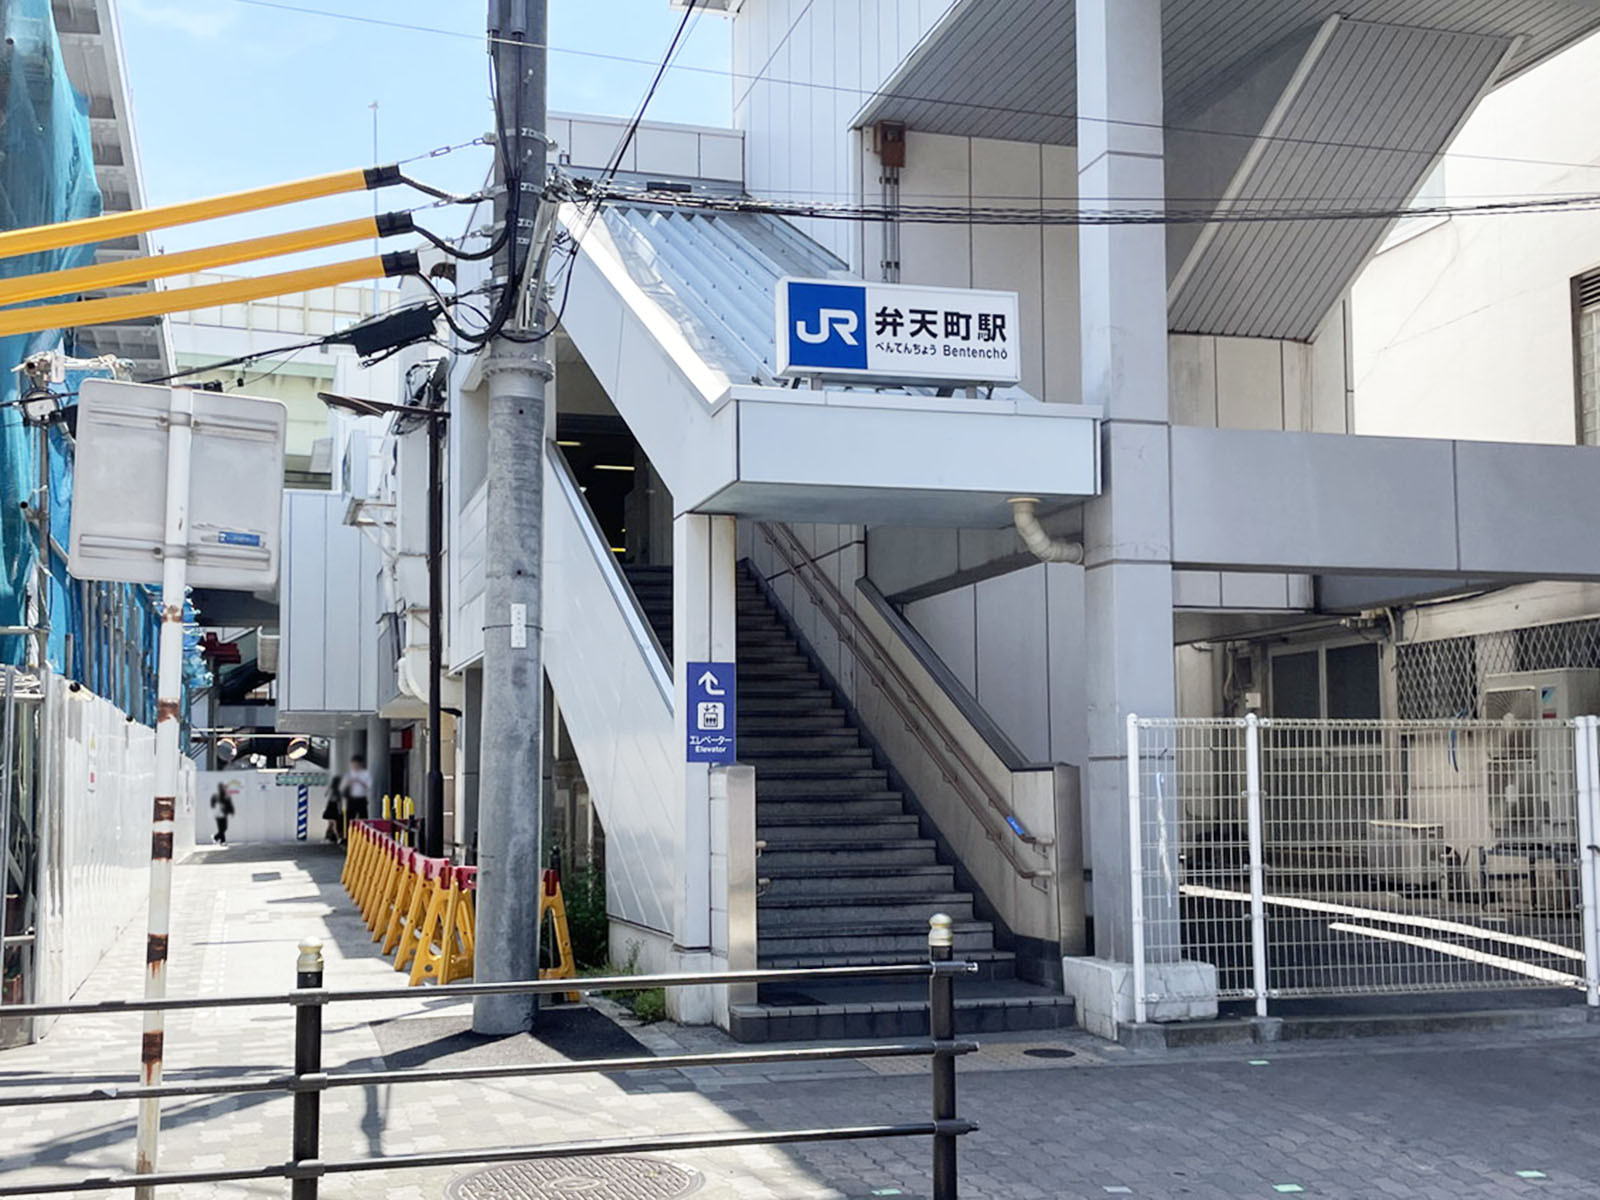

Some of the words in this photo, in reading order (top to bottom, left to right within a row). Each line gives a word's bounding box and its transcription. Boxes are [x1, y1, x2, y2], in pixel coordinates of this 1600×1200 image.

[796, 308, 859, 346] JR
[875, 306, 1007, 342] 弁天町駅
[875, 343, 937, 355] べんてんちょう
[689, 735, 732, 745] エレベーター
[695, 745, 727, 753] Elevator
